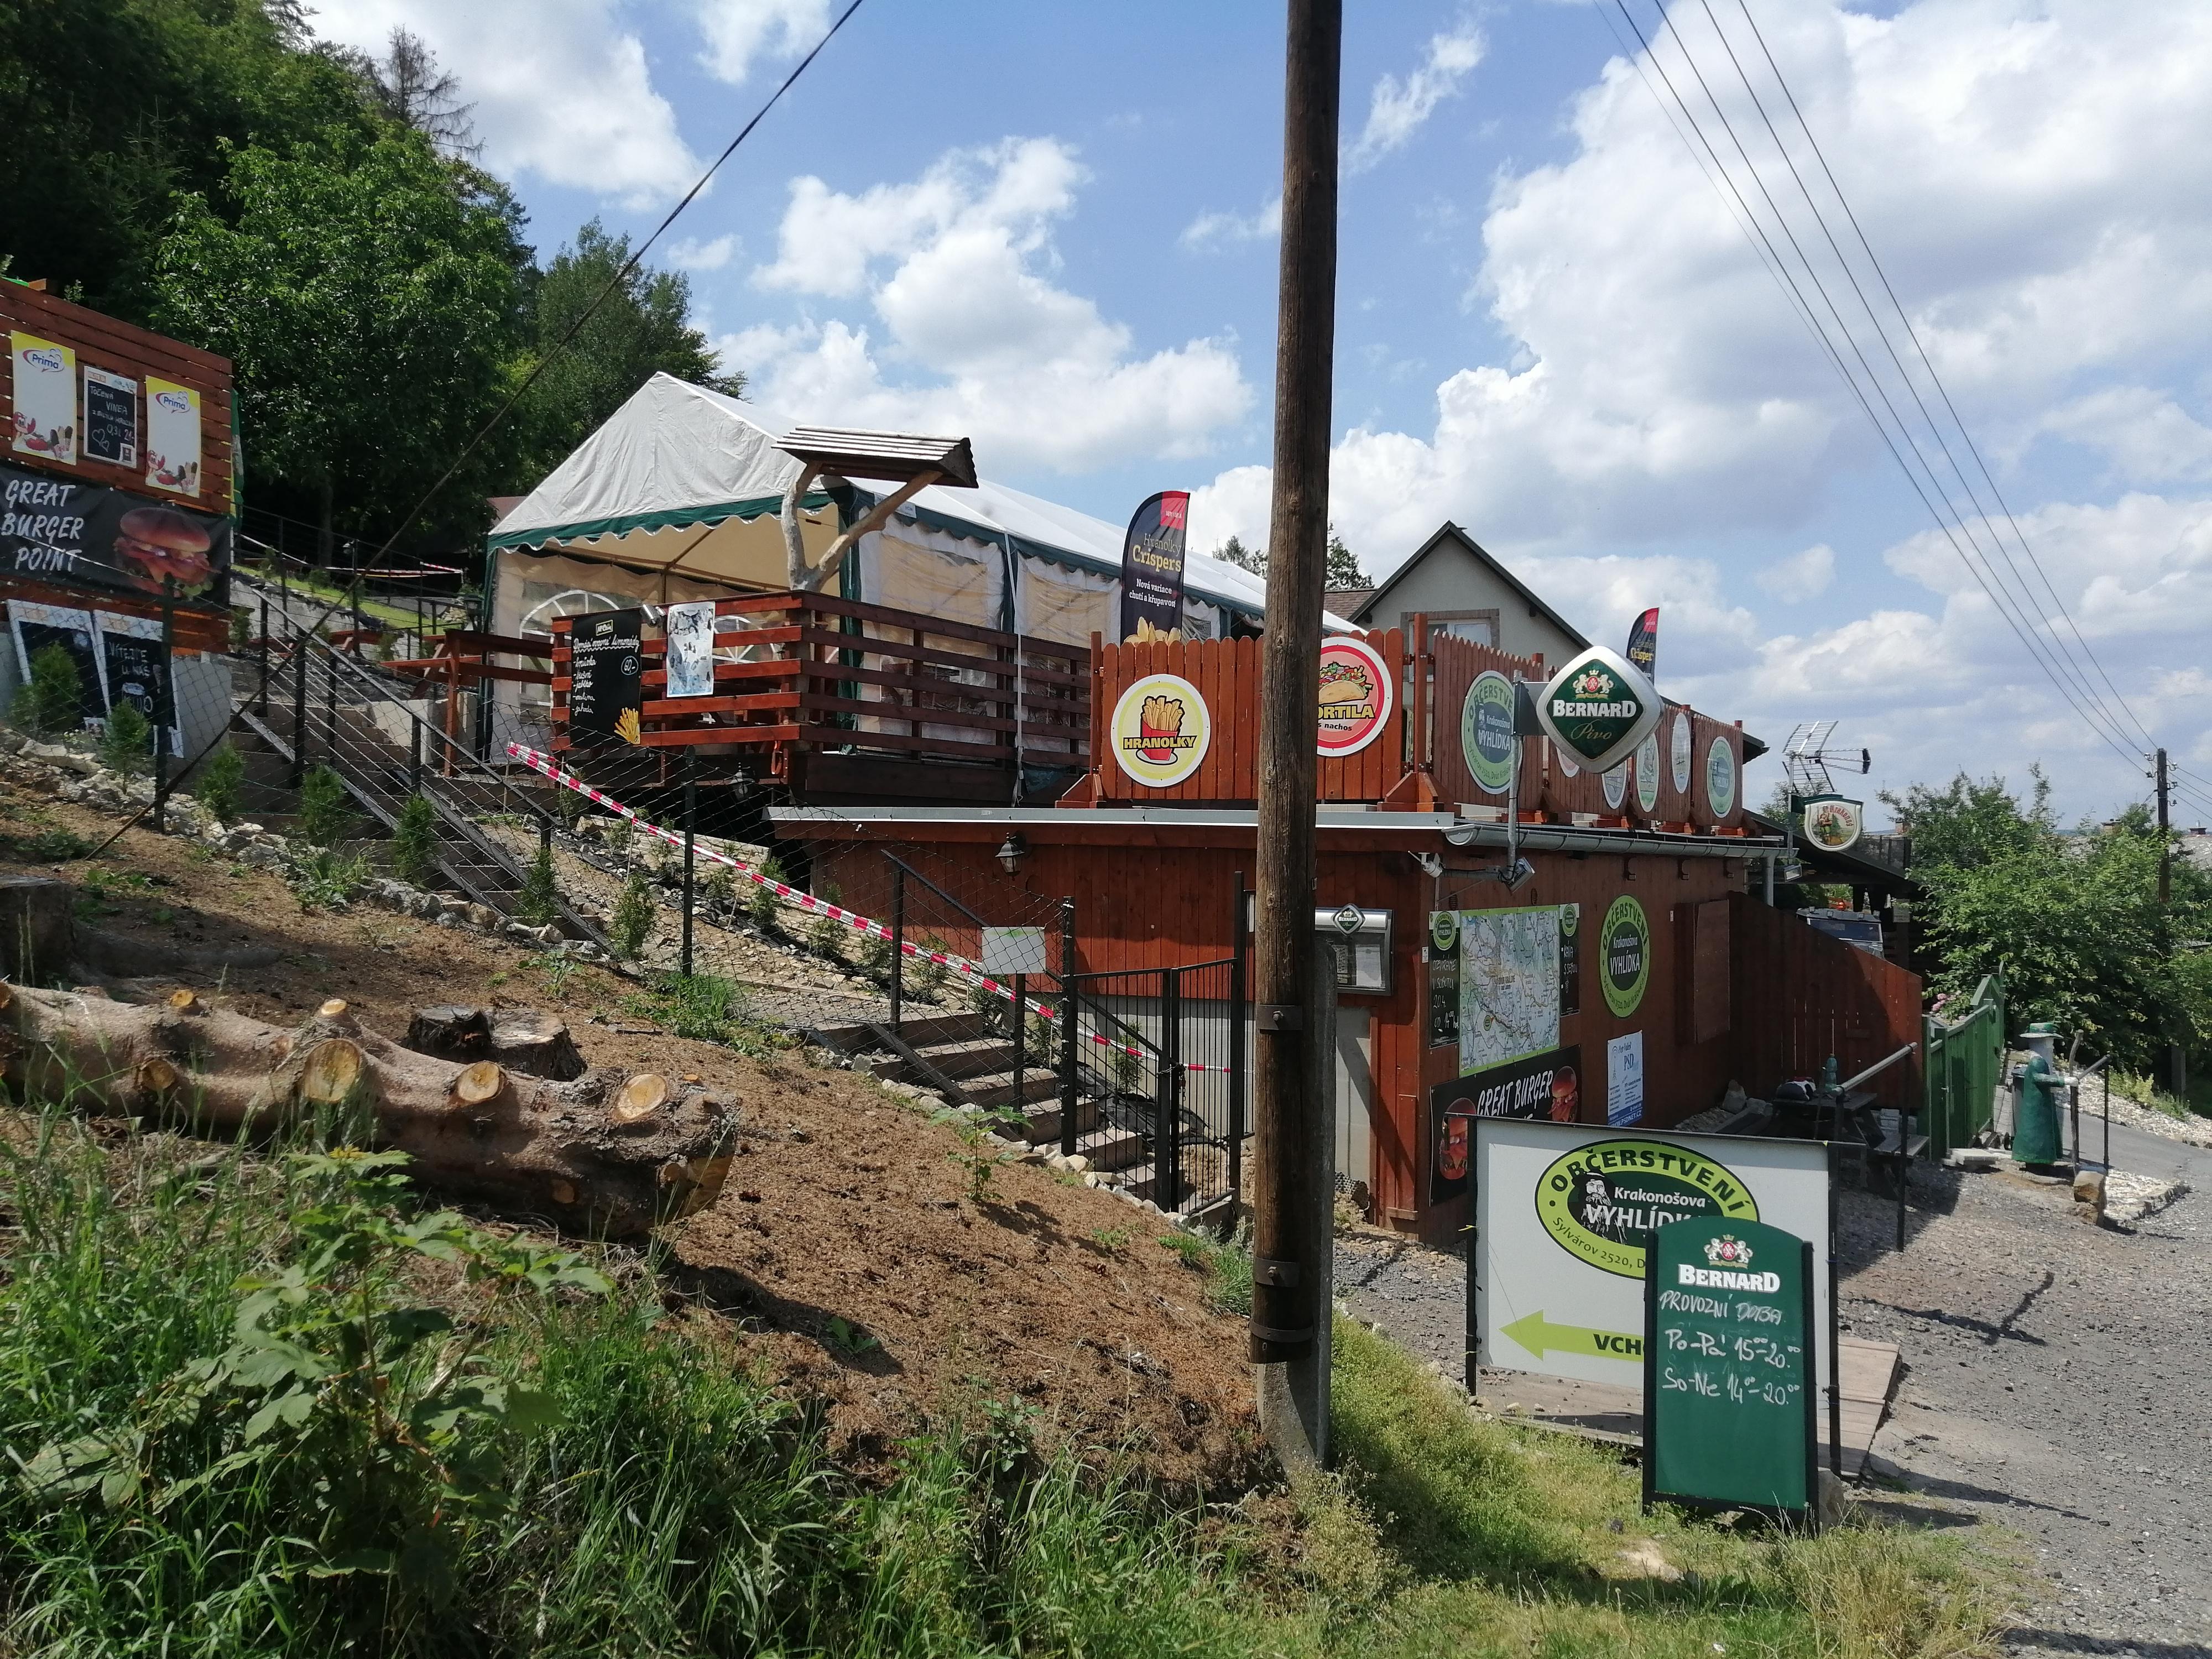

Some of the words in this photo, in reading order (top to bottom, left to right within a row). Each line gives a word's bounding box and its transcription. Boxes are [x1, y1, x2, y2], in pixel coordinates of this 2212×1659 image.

[32, 353, 59, 369] Prima
[163, 397, 186, 410] Prima
[5, 479, 76, 508] GREAT
[1, 512, 85, 545] BURGER
[1144, 533, 1182, 557] Hranolky
[14, 547, 82, 572] POINT
[1133, 545, 1182, 572] Crispers
[1129, 589, 1144, 601] chutí
[1136, 578, 1151, 590] Nová
[1151, 584, 1172, 594] variace
[1318, 705, 1375, 718] RTILA
[1469, 684, 1514, 720] OBČERSTVE
[1552, 700, 1637, 717] BERNARD
[1324, 722, 1353, 731] nachos
[1570, 719, 1612, 740] Pivo
[1124, 736, 1197, 749] HRANOLKY
[1478, 728, 1511, 752] VYHLÍDKA
[1603, 902, 1648, 951] OBČERSTVENÍ
[1613, 933, 1637, 949] Krakonošova
[1610, 950, 1640, 976] VYHLÍDKA
[1624, 1053, 1634, 1071] PSD
[1477, 1081, 1514, 1117] GREAT
[1514, 1070, 1553, 1109] BURGER
[1551, 1148, 1751, 1212] OBČERSTVENÍ
[1614, 1186, 1706, 1208] Krakonošova
[1586, 1203, 1693, 1230] VYHLÍD
[1553, 1217, 1599, 1255] Sylvárov
[1601, 1250, 1633, 1269] 2520,
[1678, 1263, 1781, 1293] BERNARD
[1659, 1290, 1733, 1318] PROVOZNÍ
[1593, 1333, 1645, 1355] VCH
[1665, 1328, 1726, 1357] Po-Pá
[1662, 1367, 1721, 1396] So-Ne
